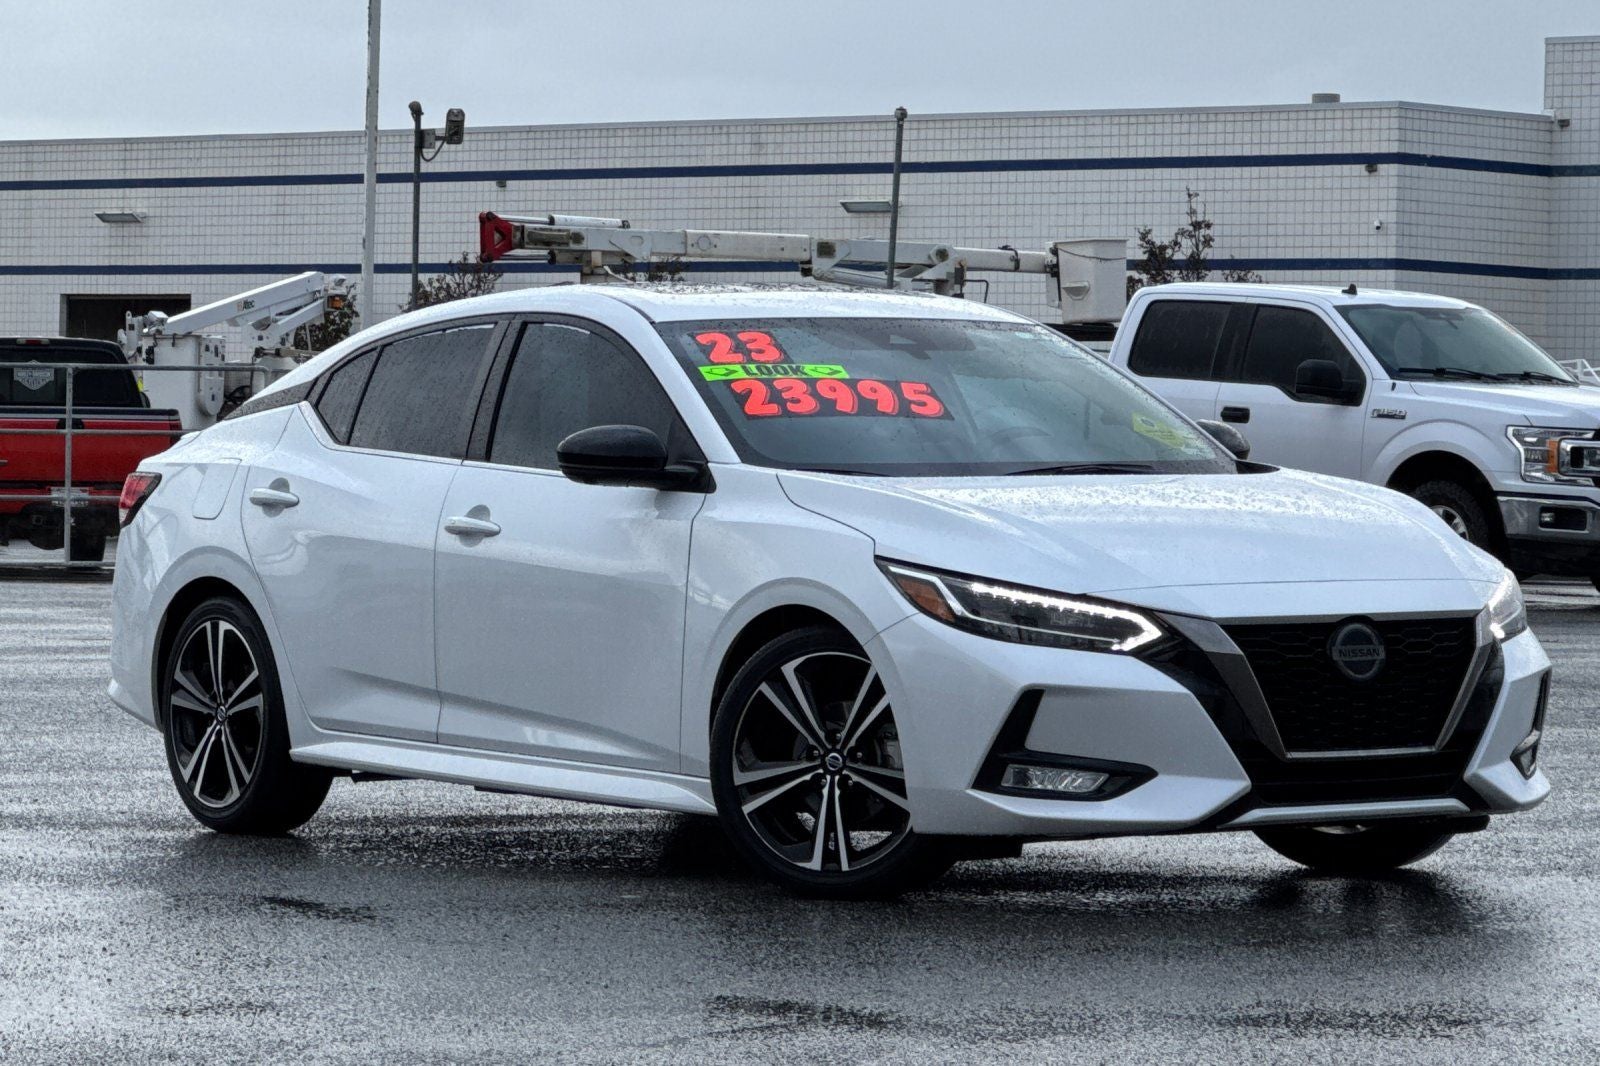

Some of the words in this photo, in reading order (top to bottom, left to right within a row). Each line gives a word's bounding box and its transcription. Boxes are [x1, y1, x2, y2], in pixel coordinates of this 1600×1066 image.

[695, 331, 784, 364] 23
[741, 365, 809, 377] LOOK
[731, 378, 945, 416] 23995
[1338, 648, 1380, 658] NISSAN
